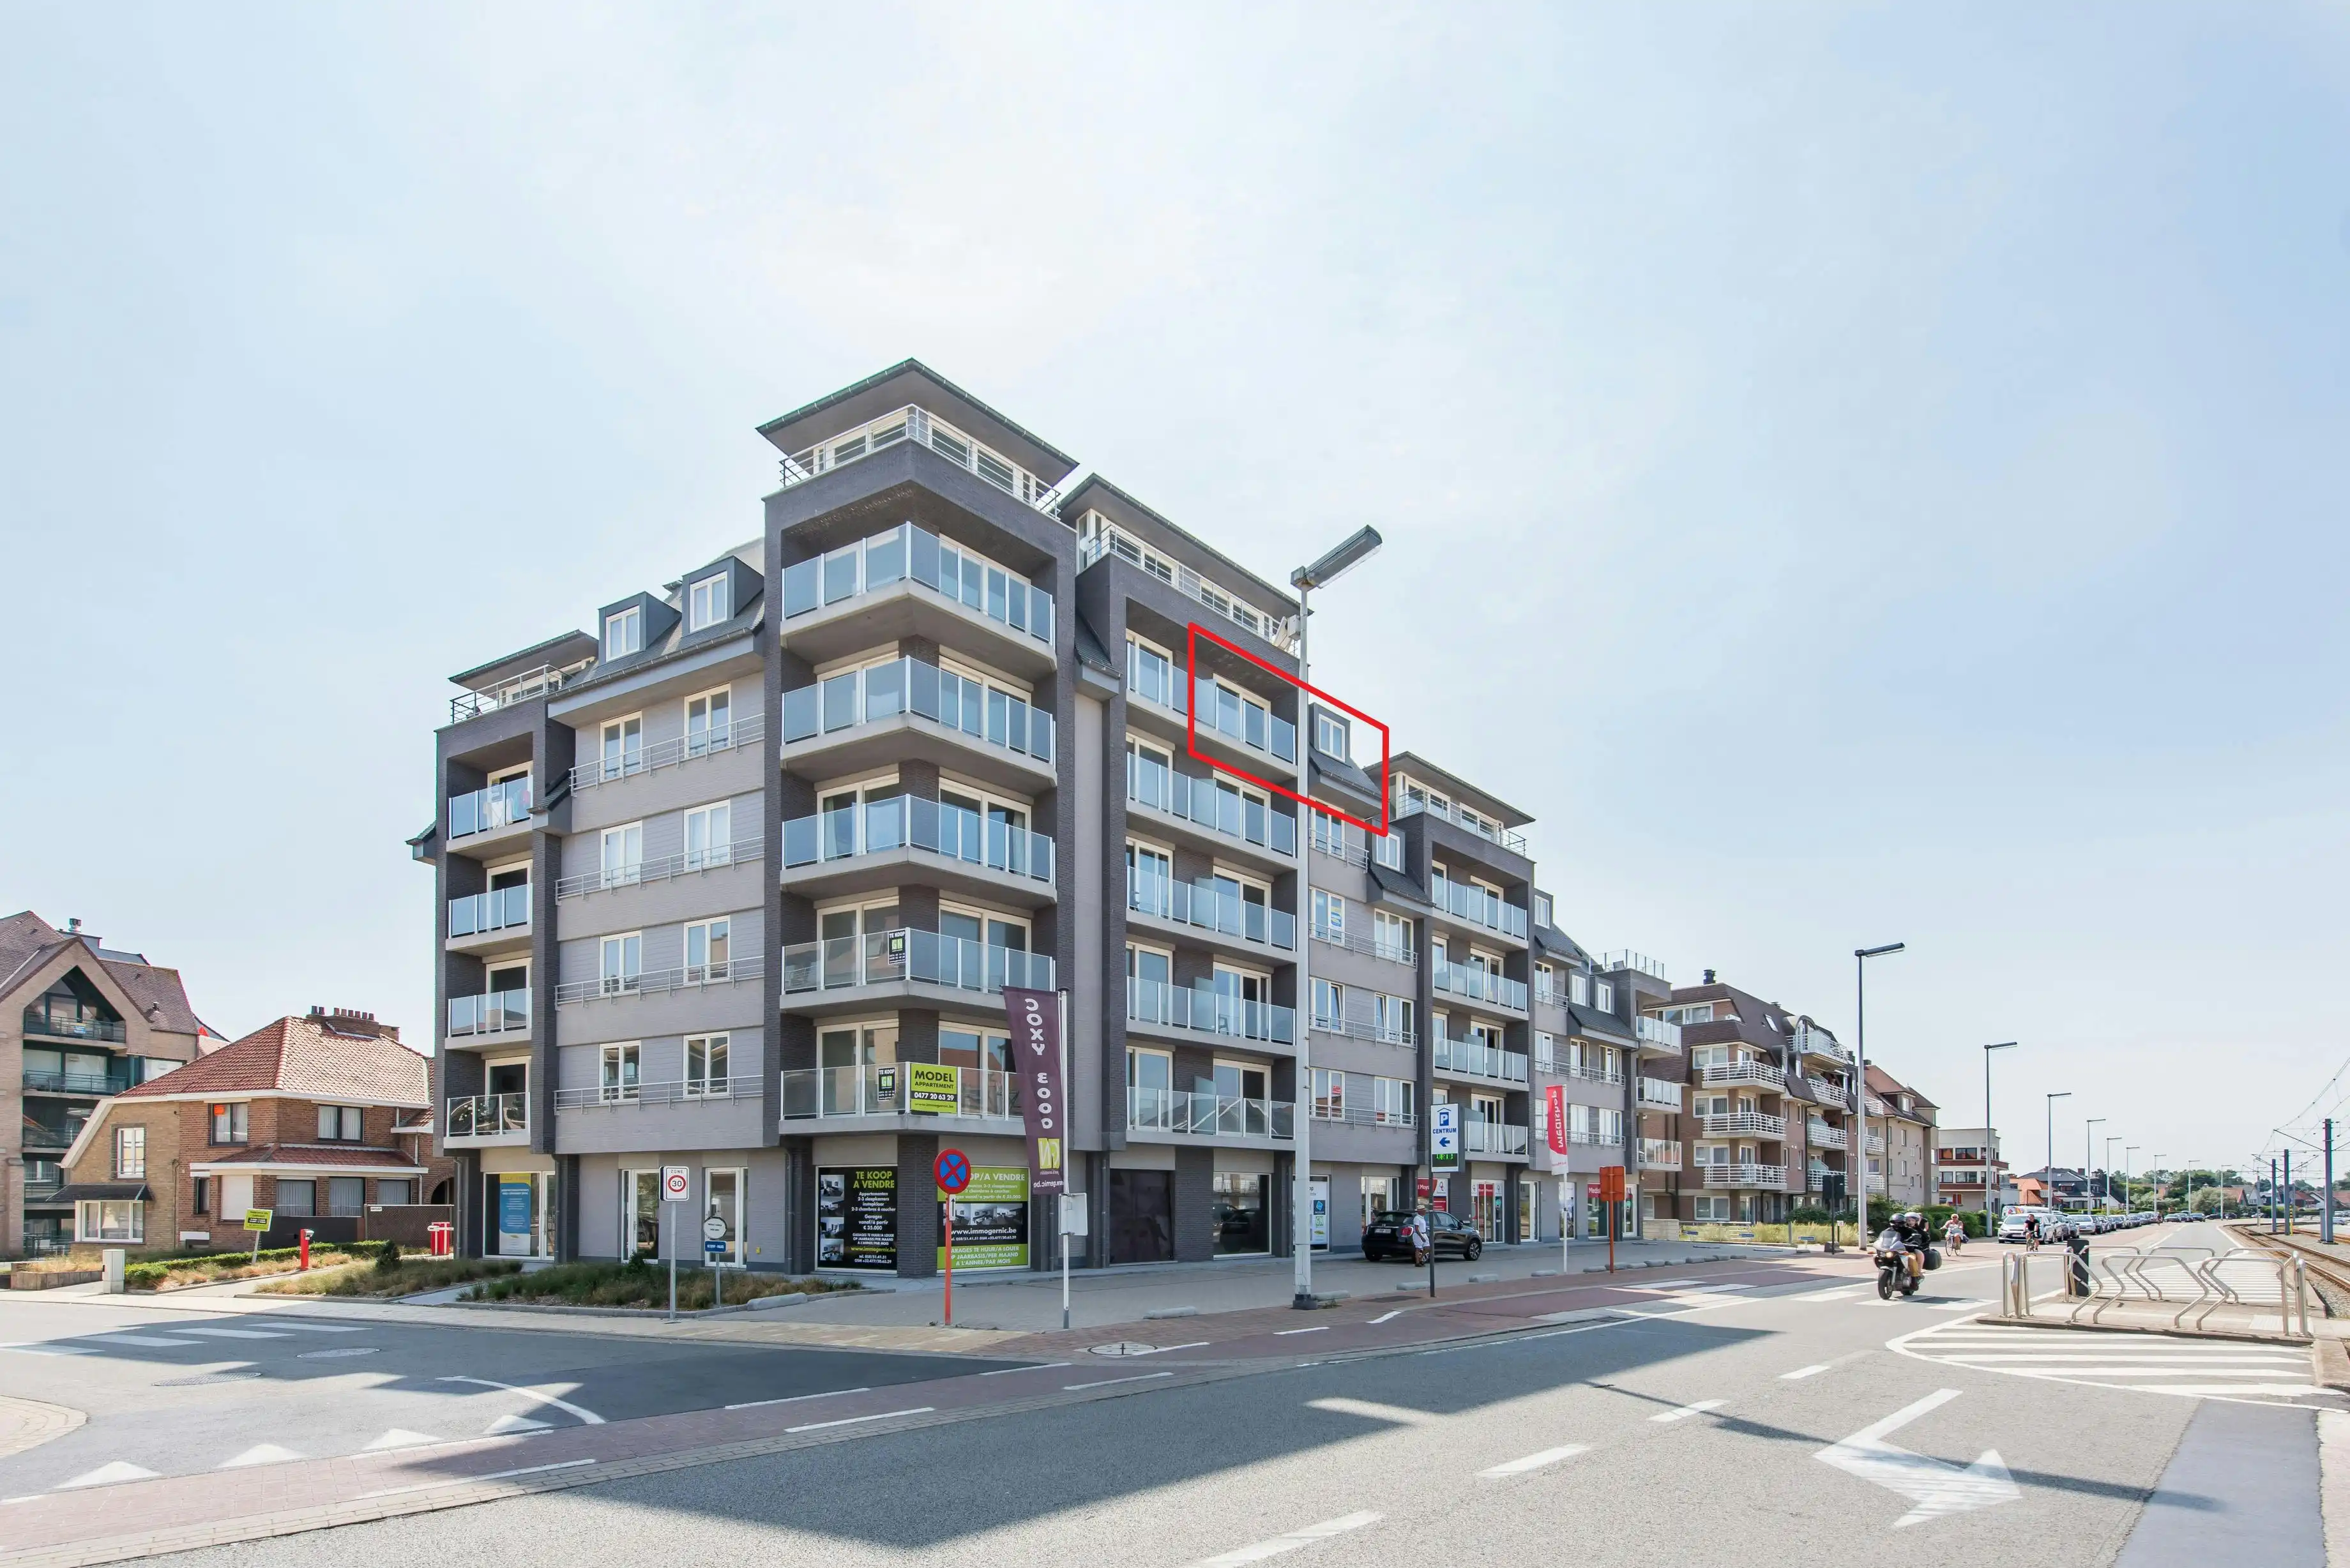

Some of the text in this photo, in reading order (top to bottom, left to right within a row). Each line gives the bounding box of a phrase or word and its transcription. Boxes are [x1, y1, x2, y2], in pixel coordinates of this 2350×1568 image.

[914, 1071, 954, 1082] MODEL
[1440, 1113, 1448, 1124] P
[867, 1171, 892, 1179] KOOP
[951, 1227, 1017, 1235] www.immogernic.be
